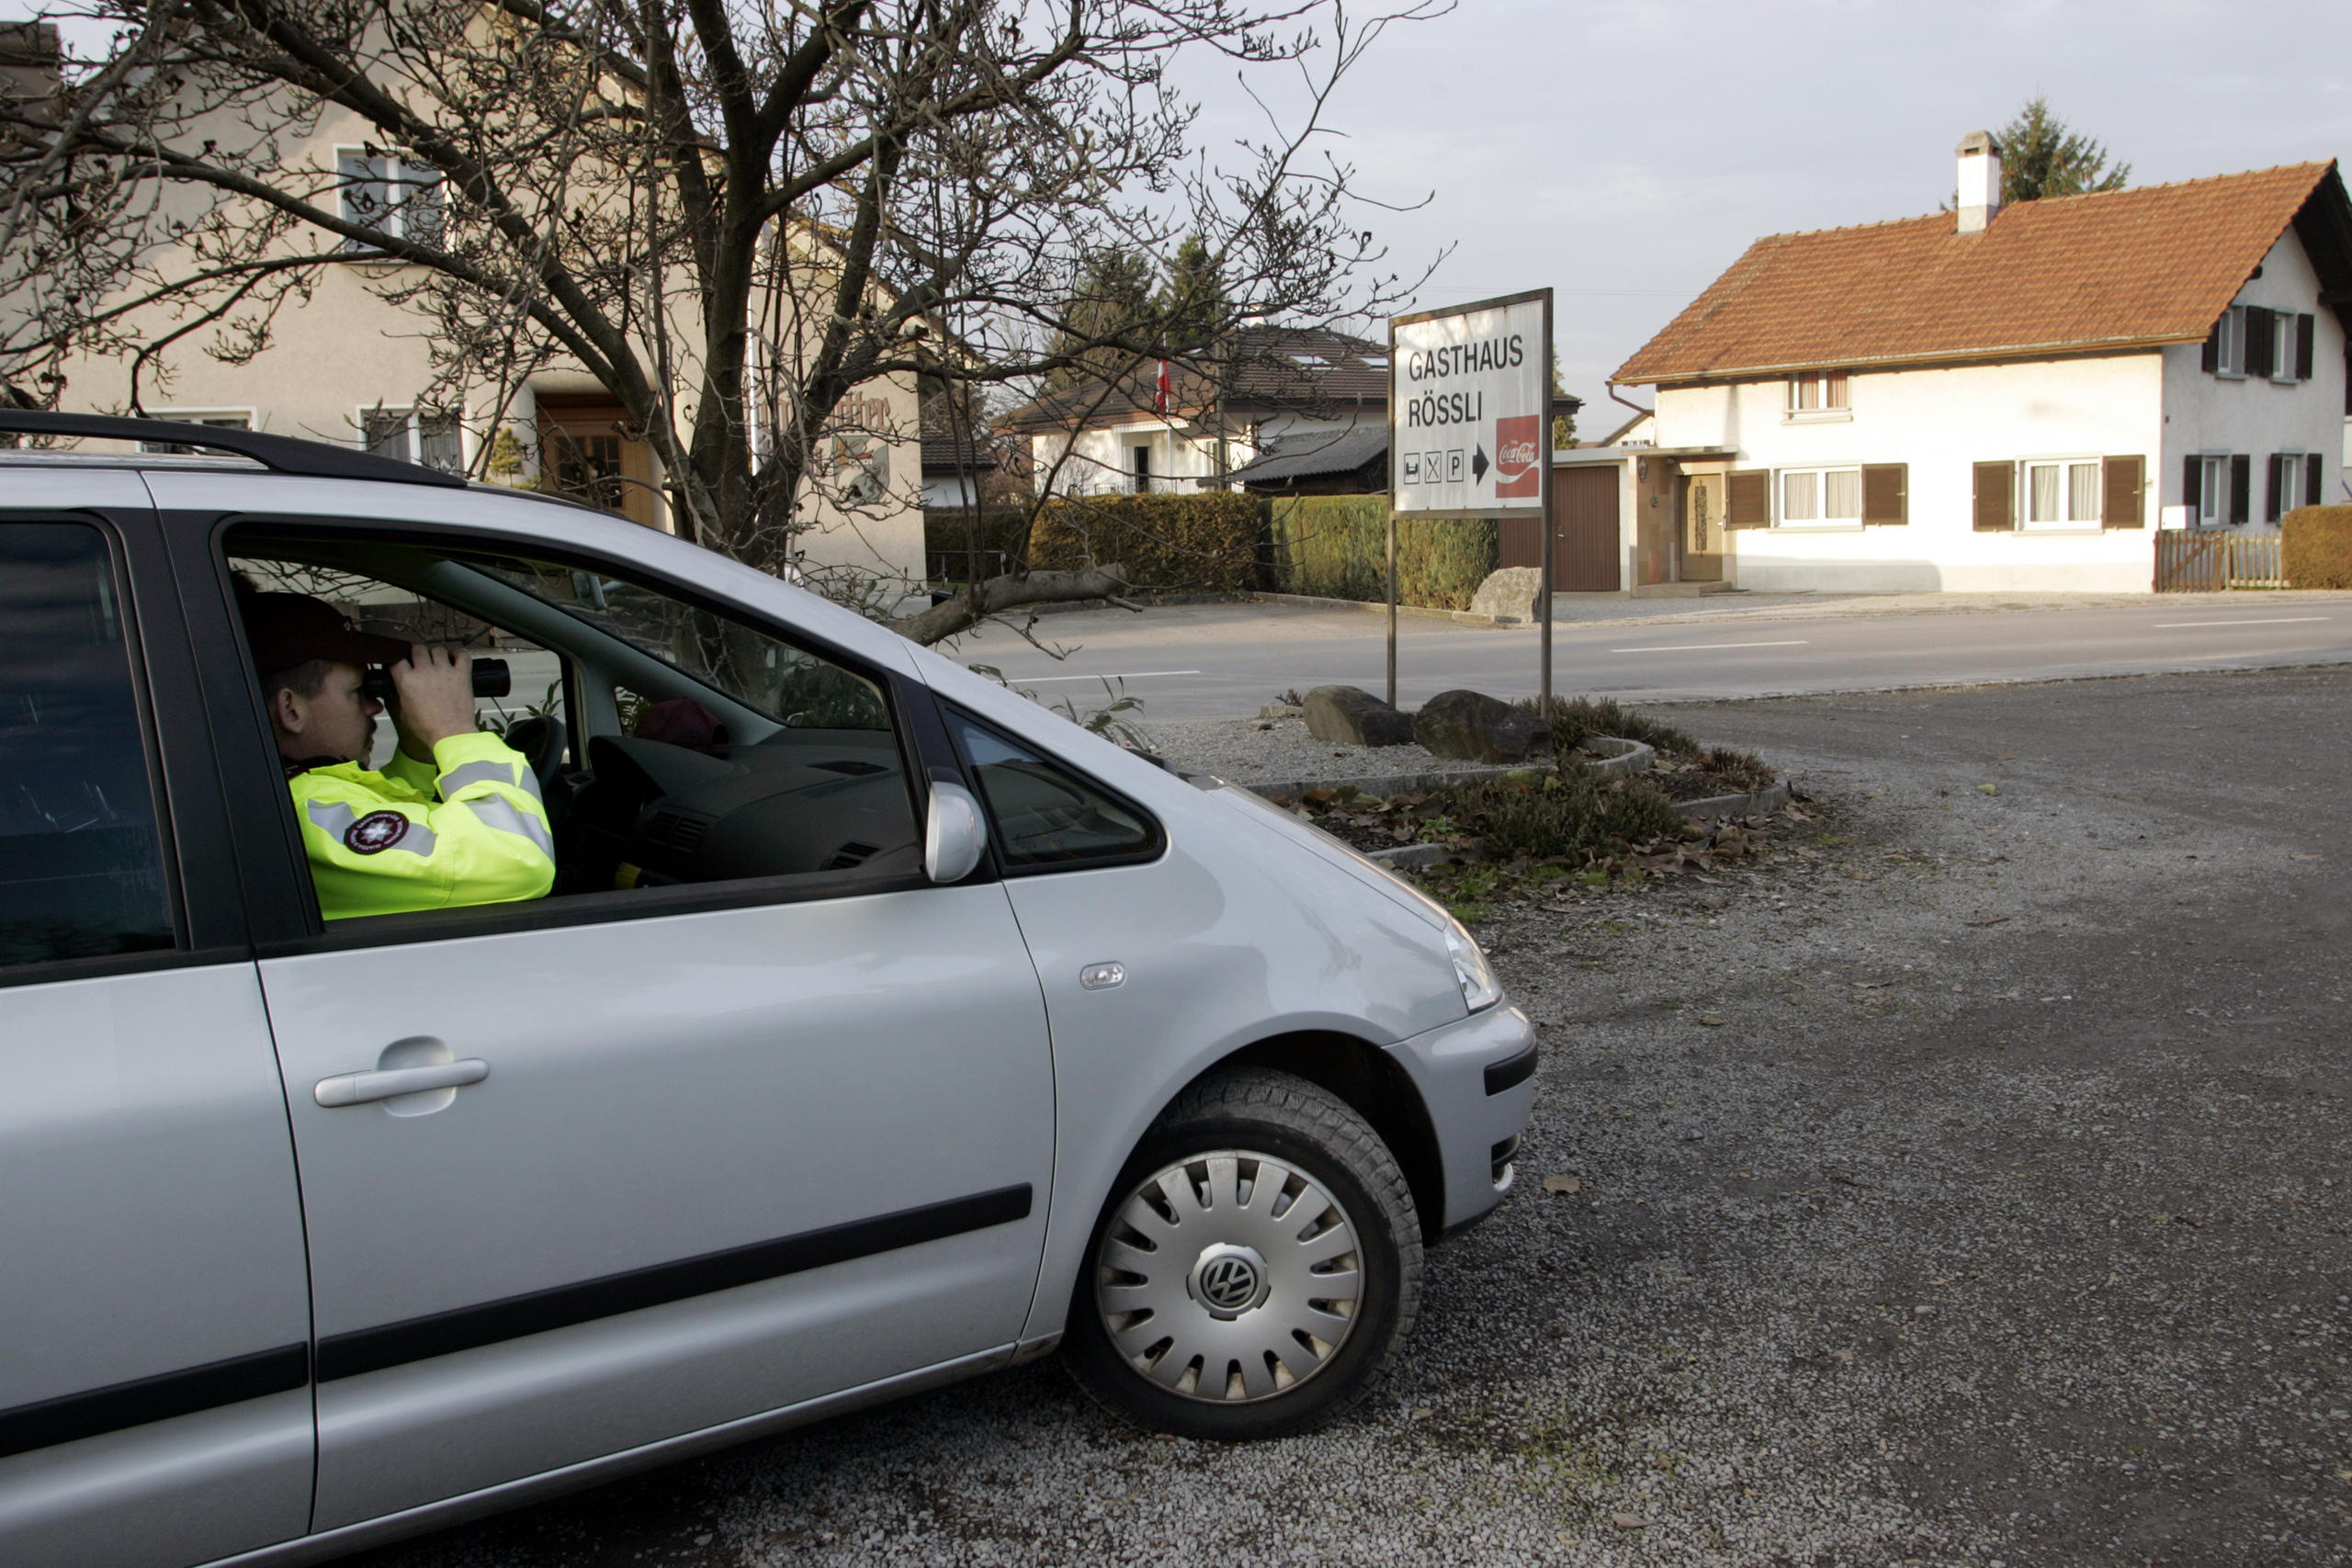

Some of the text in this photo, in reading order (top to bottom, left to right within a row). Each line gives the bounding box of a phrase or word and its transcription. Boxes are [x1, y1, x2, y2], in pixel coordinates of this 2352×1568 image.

[1408, 334, 1523, 381] GASTHAUS
[1408, 389, 1482, 427] RÖSSLI
[1452, 456, 1460, 477] P
